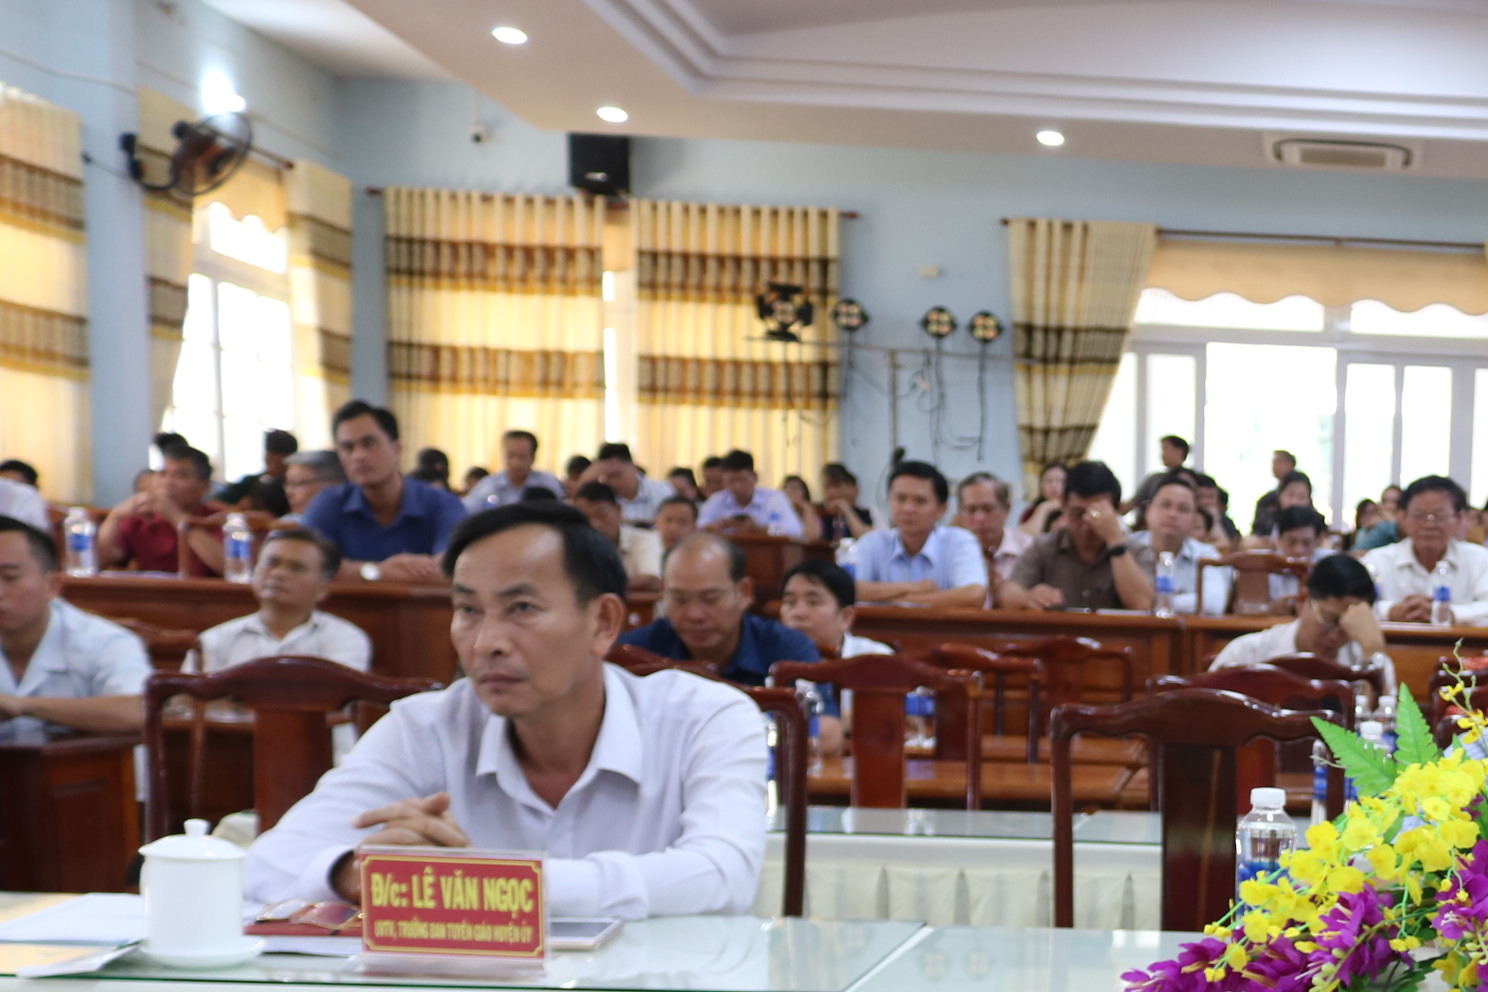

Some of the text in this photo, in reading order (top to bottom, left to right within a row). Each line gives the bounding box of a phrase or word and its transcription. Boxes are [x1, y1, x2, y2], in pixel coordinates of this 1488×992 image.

[370, 866, 533, 919] Đ/c: LÊ VĂN NGỌC
